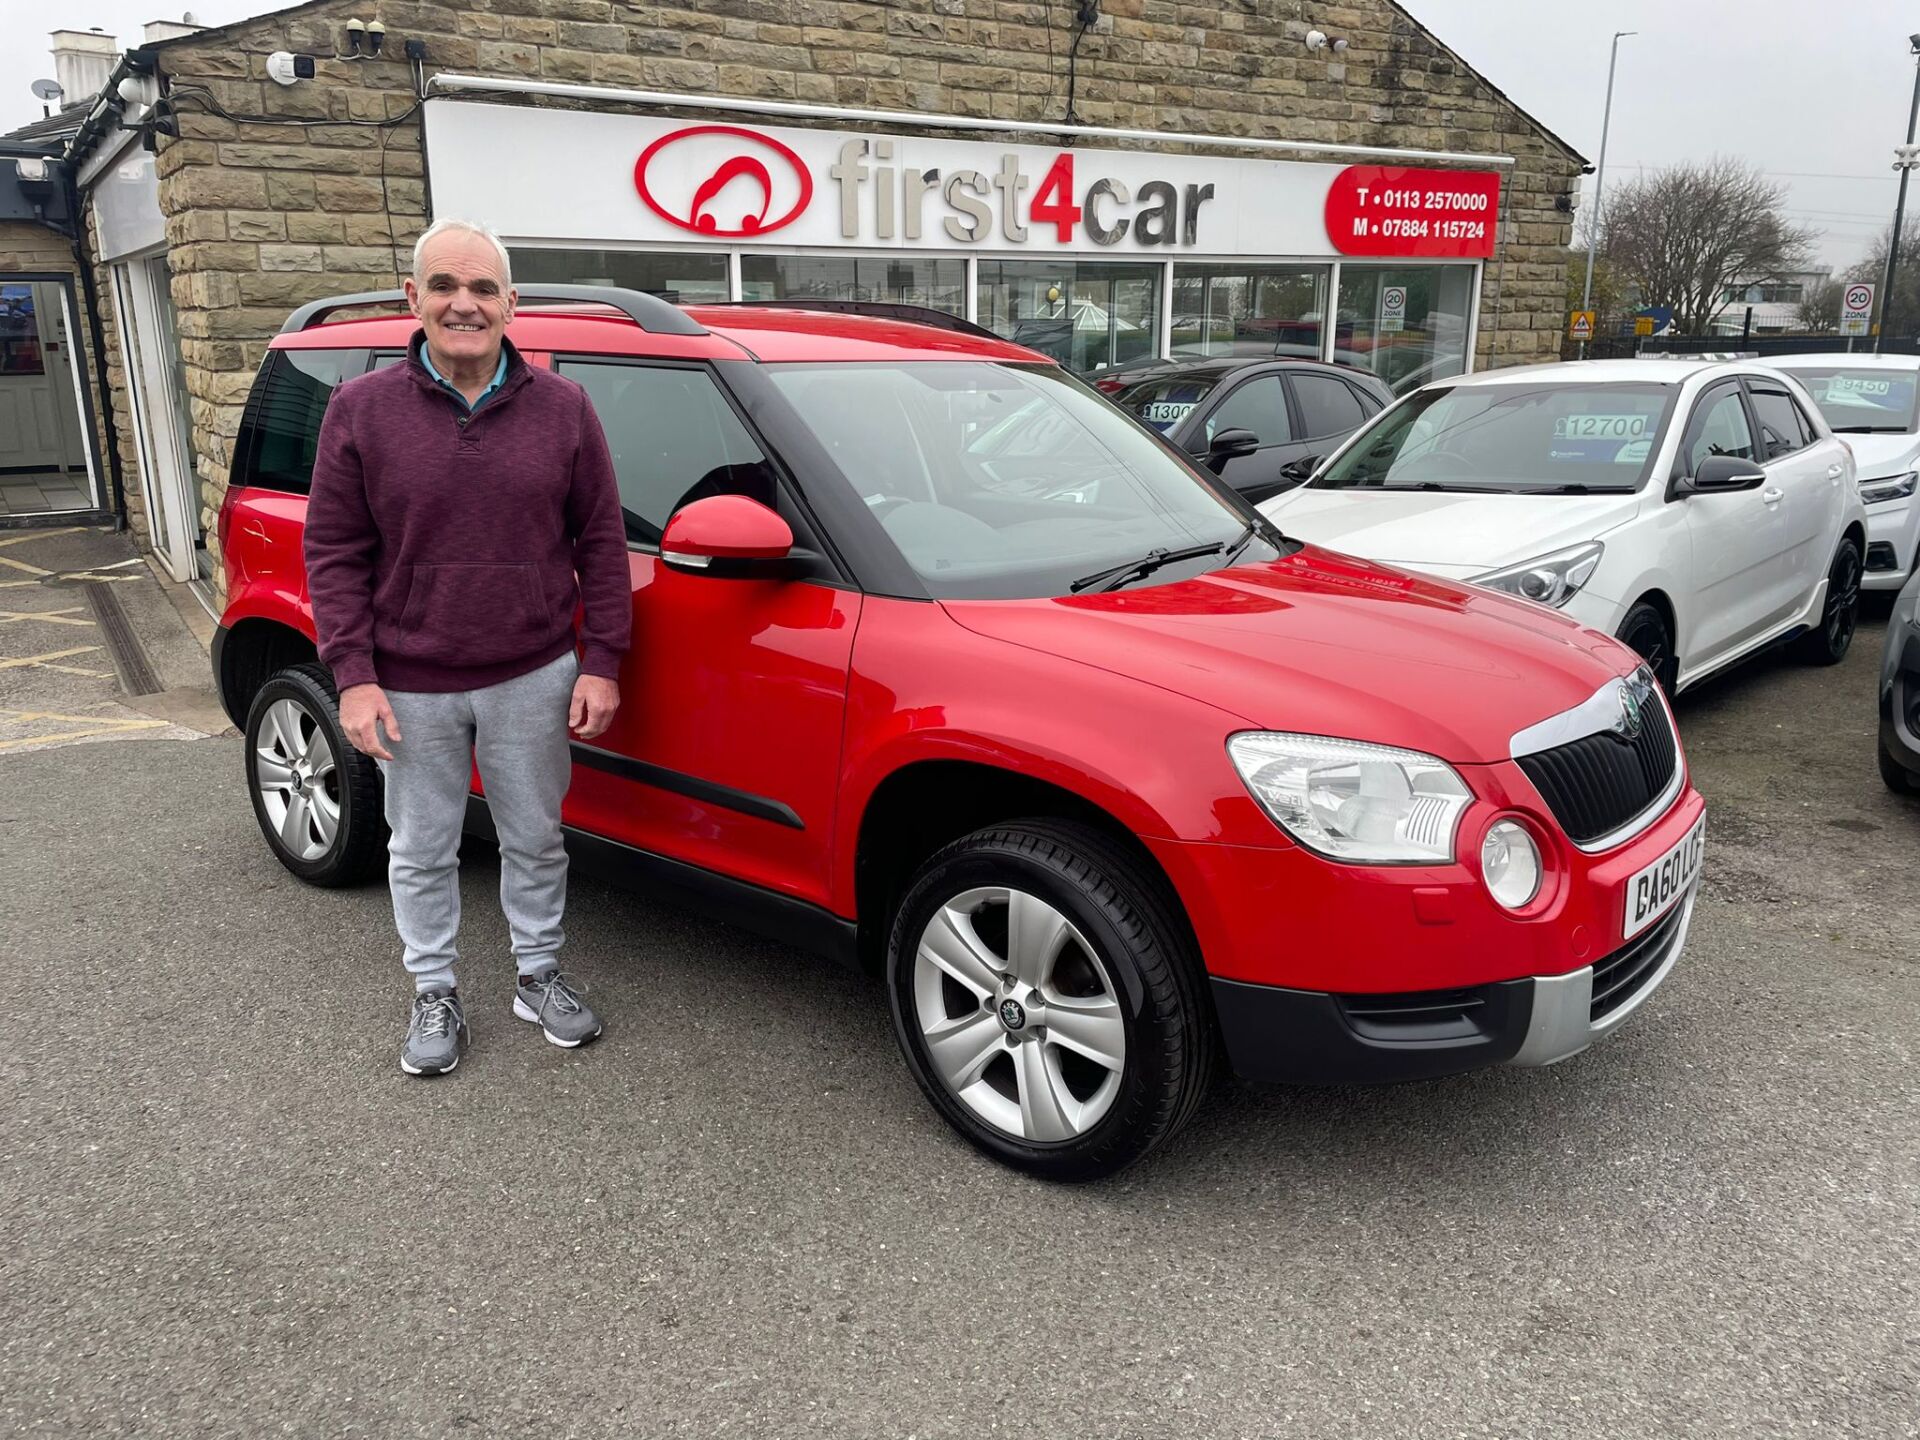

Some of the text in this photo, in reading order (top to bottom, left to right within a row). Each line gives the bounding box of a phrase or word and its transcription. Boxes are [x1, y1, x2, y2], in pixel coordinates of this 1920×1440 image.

[831, 139, 1215, 247] first4car
[1357, 188, 1488, 211] T 0113 2570000
[1353, 217, 1485, 239] M 07884 115724
[1387, 294, 1400, 304] 20
[1850, 292, 1868, 303] 20
[1845, 311, 1868, 319] ZONE
